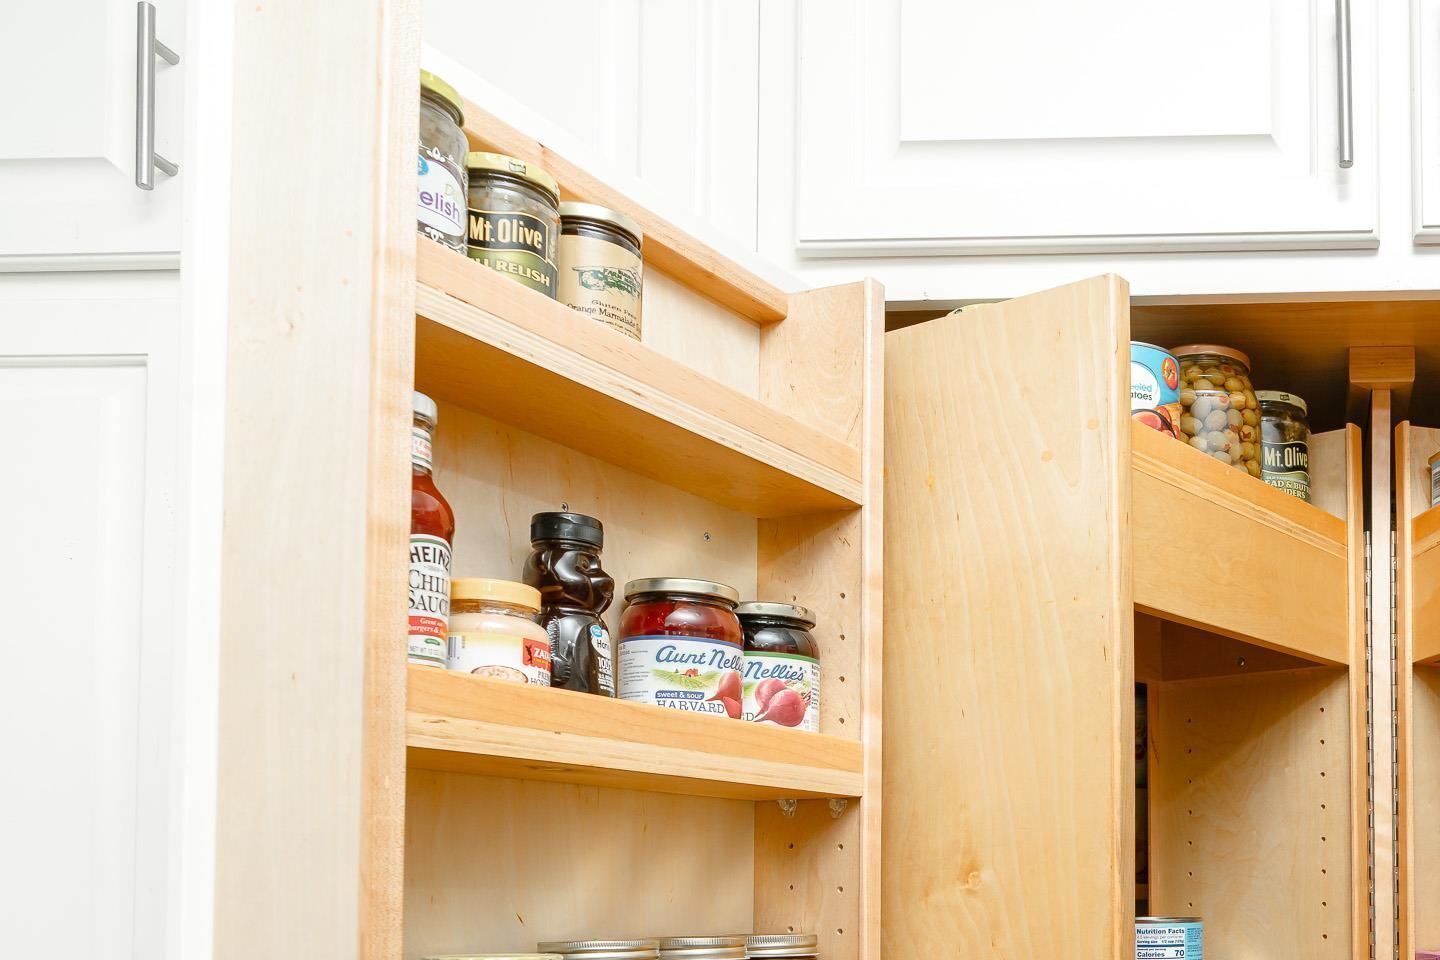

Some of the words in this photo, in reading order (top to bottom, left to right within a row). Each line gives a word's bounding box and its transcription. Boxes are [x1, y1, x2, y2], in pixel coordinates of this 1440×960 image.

[469, 214, 495, 243] Mt.
[497, 218, 543, 250] Olive
[495, 259, 550, 287] RELISH
[1264, 446, 1284, 467] Mt.
[1284, 446, 1308, 468] Olive
[655, 645, 706, 664] Aunt
[744, 661, 805, 681] Nellie's
[656, 690, 679, 699] sweet
[656, 700, 725, 714] HARVARD
[1174, 949, 1185, 957] 70
